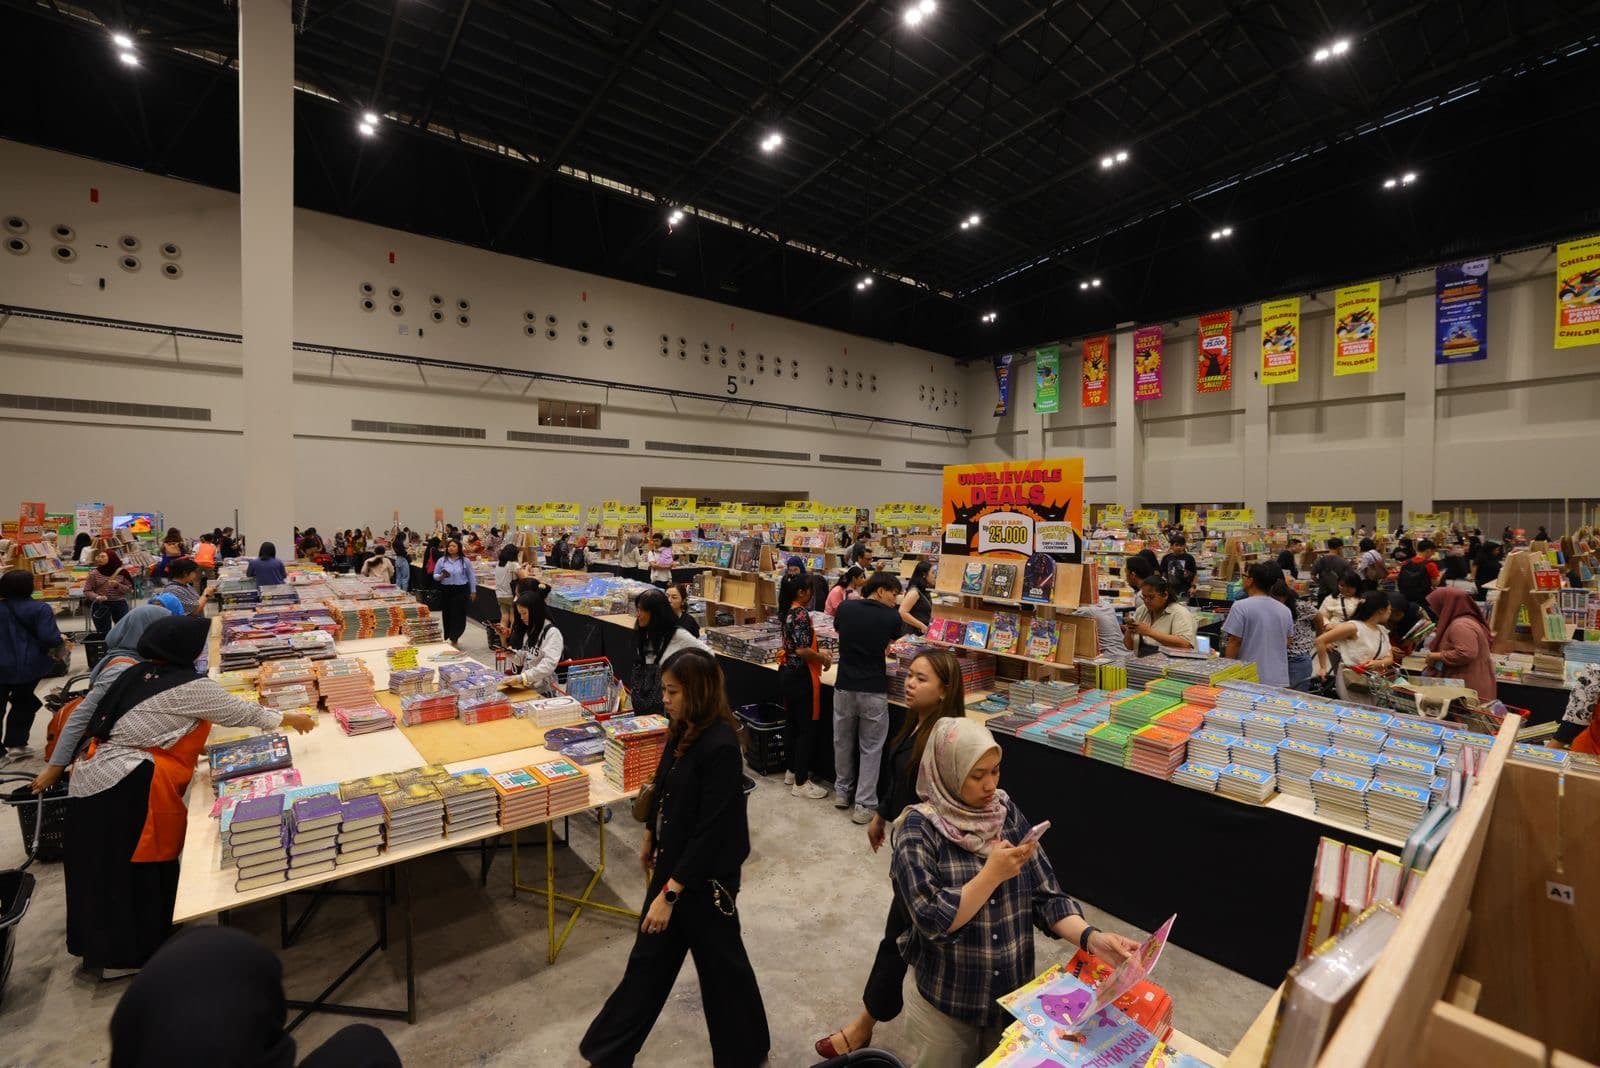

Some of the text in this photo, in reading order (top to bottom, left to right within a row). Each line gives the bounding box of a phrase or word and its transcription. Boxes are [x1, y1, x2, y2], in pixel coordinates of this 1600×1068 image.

[1337, 297, 1376, 309] CHILDREN
[1264, 312, 1297, 323] CHILDREN
[1568, 309, 1600, 319] PENU
[1138, 335, 1158, 343] BEST
[1136, 340, 1161, 349] SELLER
[1336, 357, 1375, 367] CHILDREN
[1263, 367, 1297, 377] CHILDREN
[727, 375, 738, 395] 5
[1138, 382, 1158, 391] BEST
[1136, 388, 1161, 396] SELLER
[1088, 396, 1101, 404] 10
[958, 468, 1062, 485] UNBELIEVABLE
[970, 485, 1046, 506] DEALS
[988, 525, 1028, 544] 25.000
[1550, 887, 1571, 900] A1
[1081, 1027, 1150, 1068] NARWHAL
